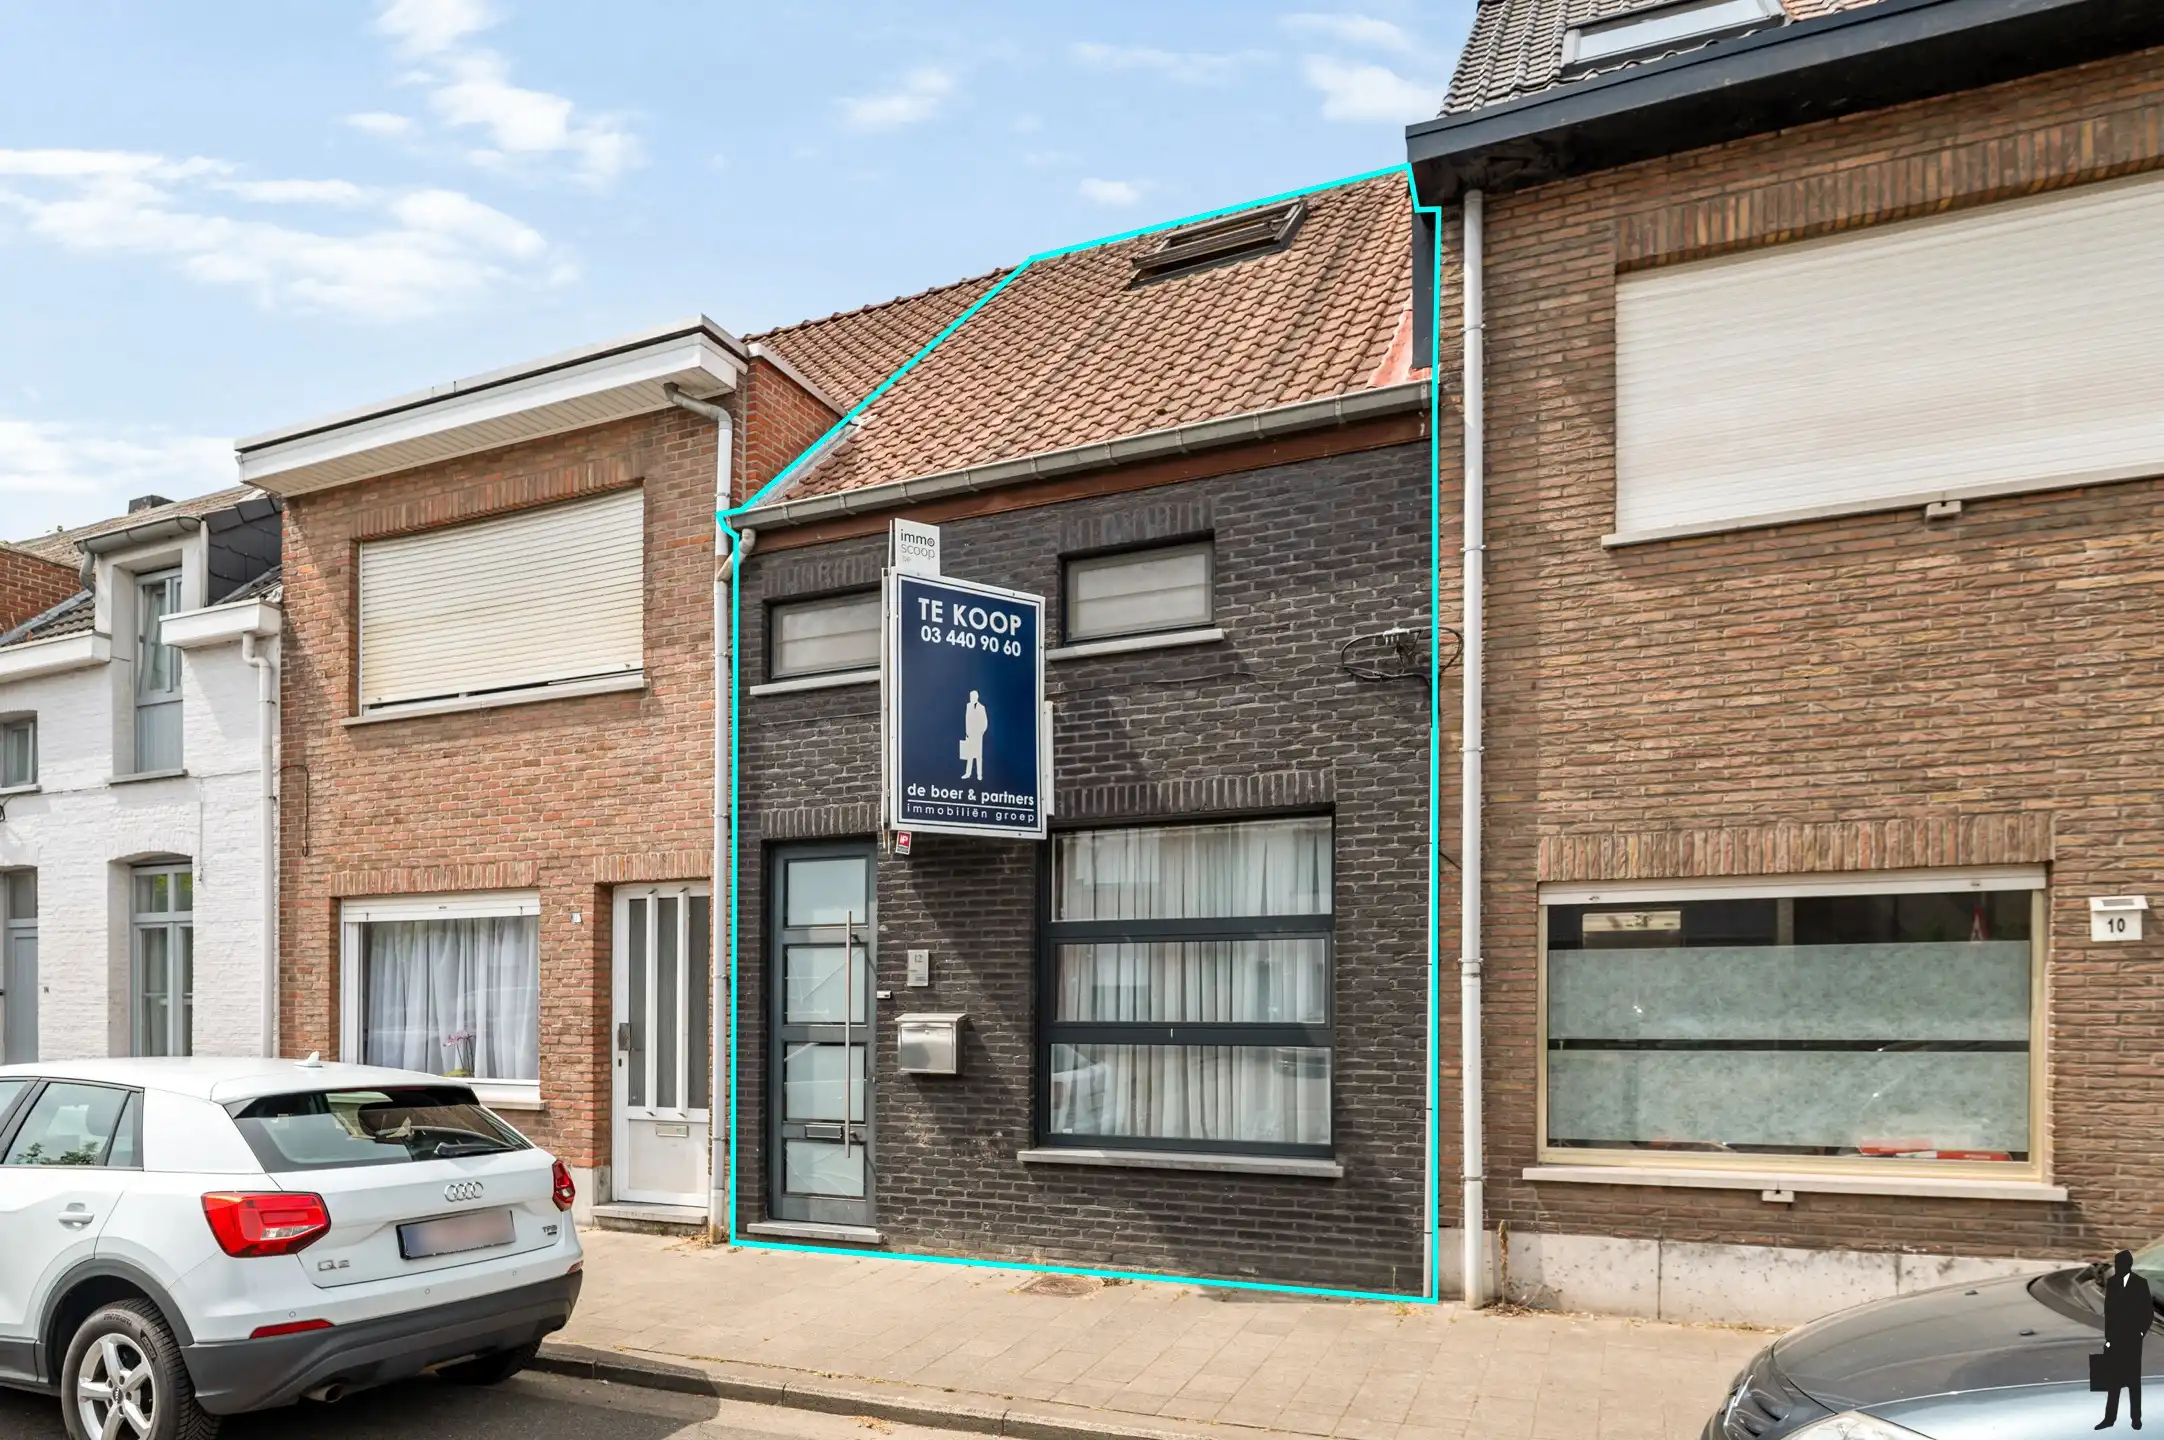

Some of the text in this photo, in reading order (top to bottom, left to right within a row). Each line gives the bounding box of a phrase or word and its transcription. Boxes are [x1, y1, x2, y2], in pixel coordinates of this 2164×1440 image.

[900, 528, 936, 548] immo
[900, 543, 936, 561] scoop
[917, 597, 1022, 636] TE KOOP
[920, 625, 1022, 657] 03 440 90 60
[907, 783, 1034, 806] de boer & partners
[907, 802, 1034, 823] immobiliën groep
[2107, 917, 2126, 934] 10
[317, 1259, 351, 1272] Q2
